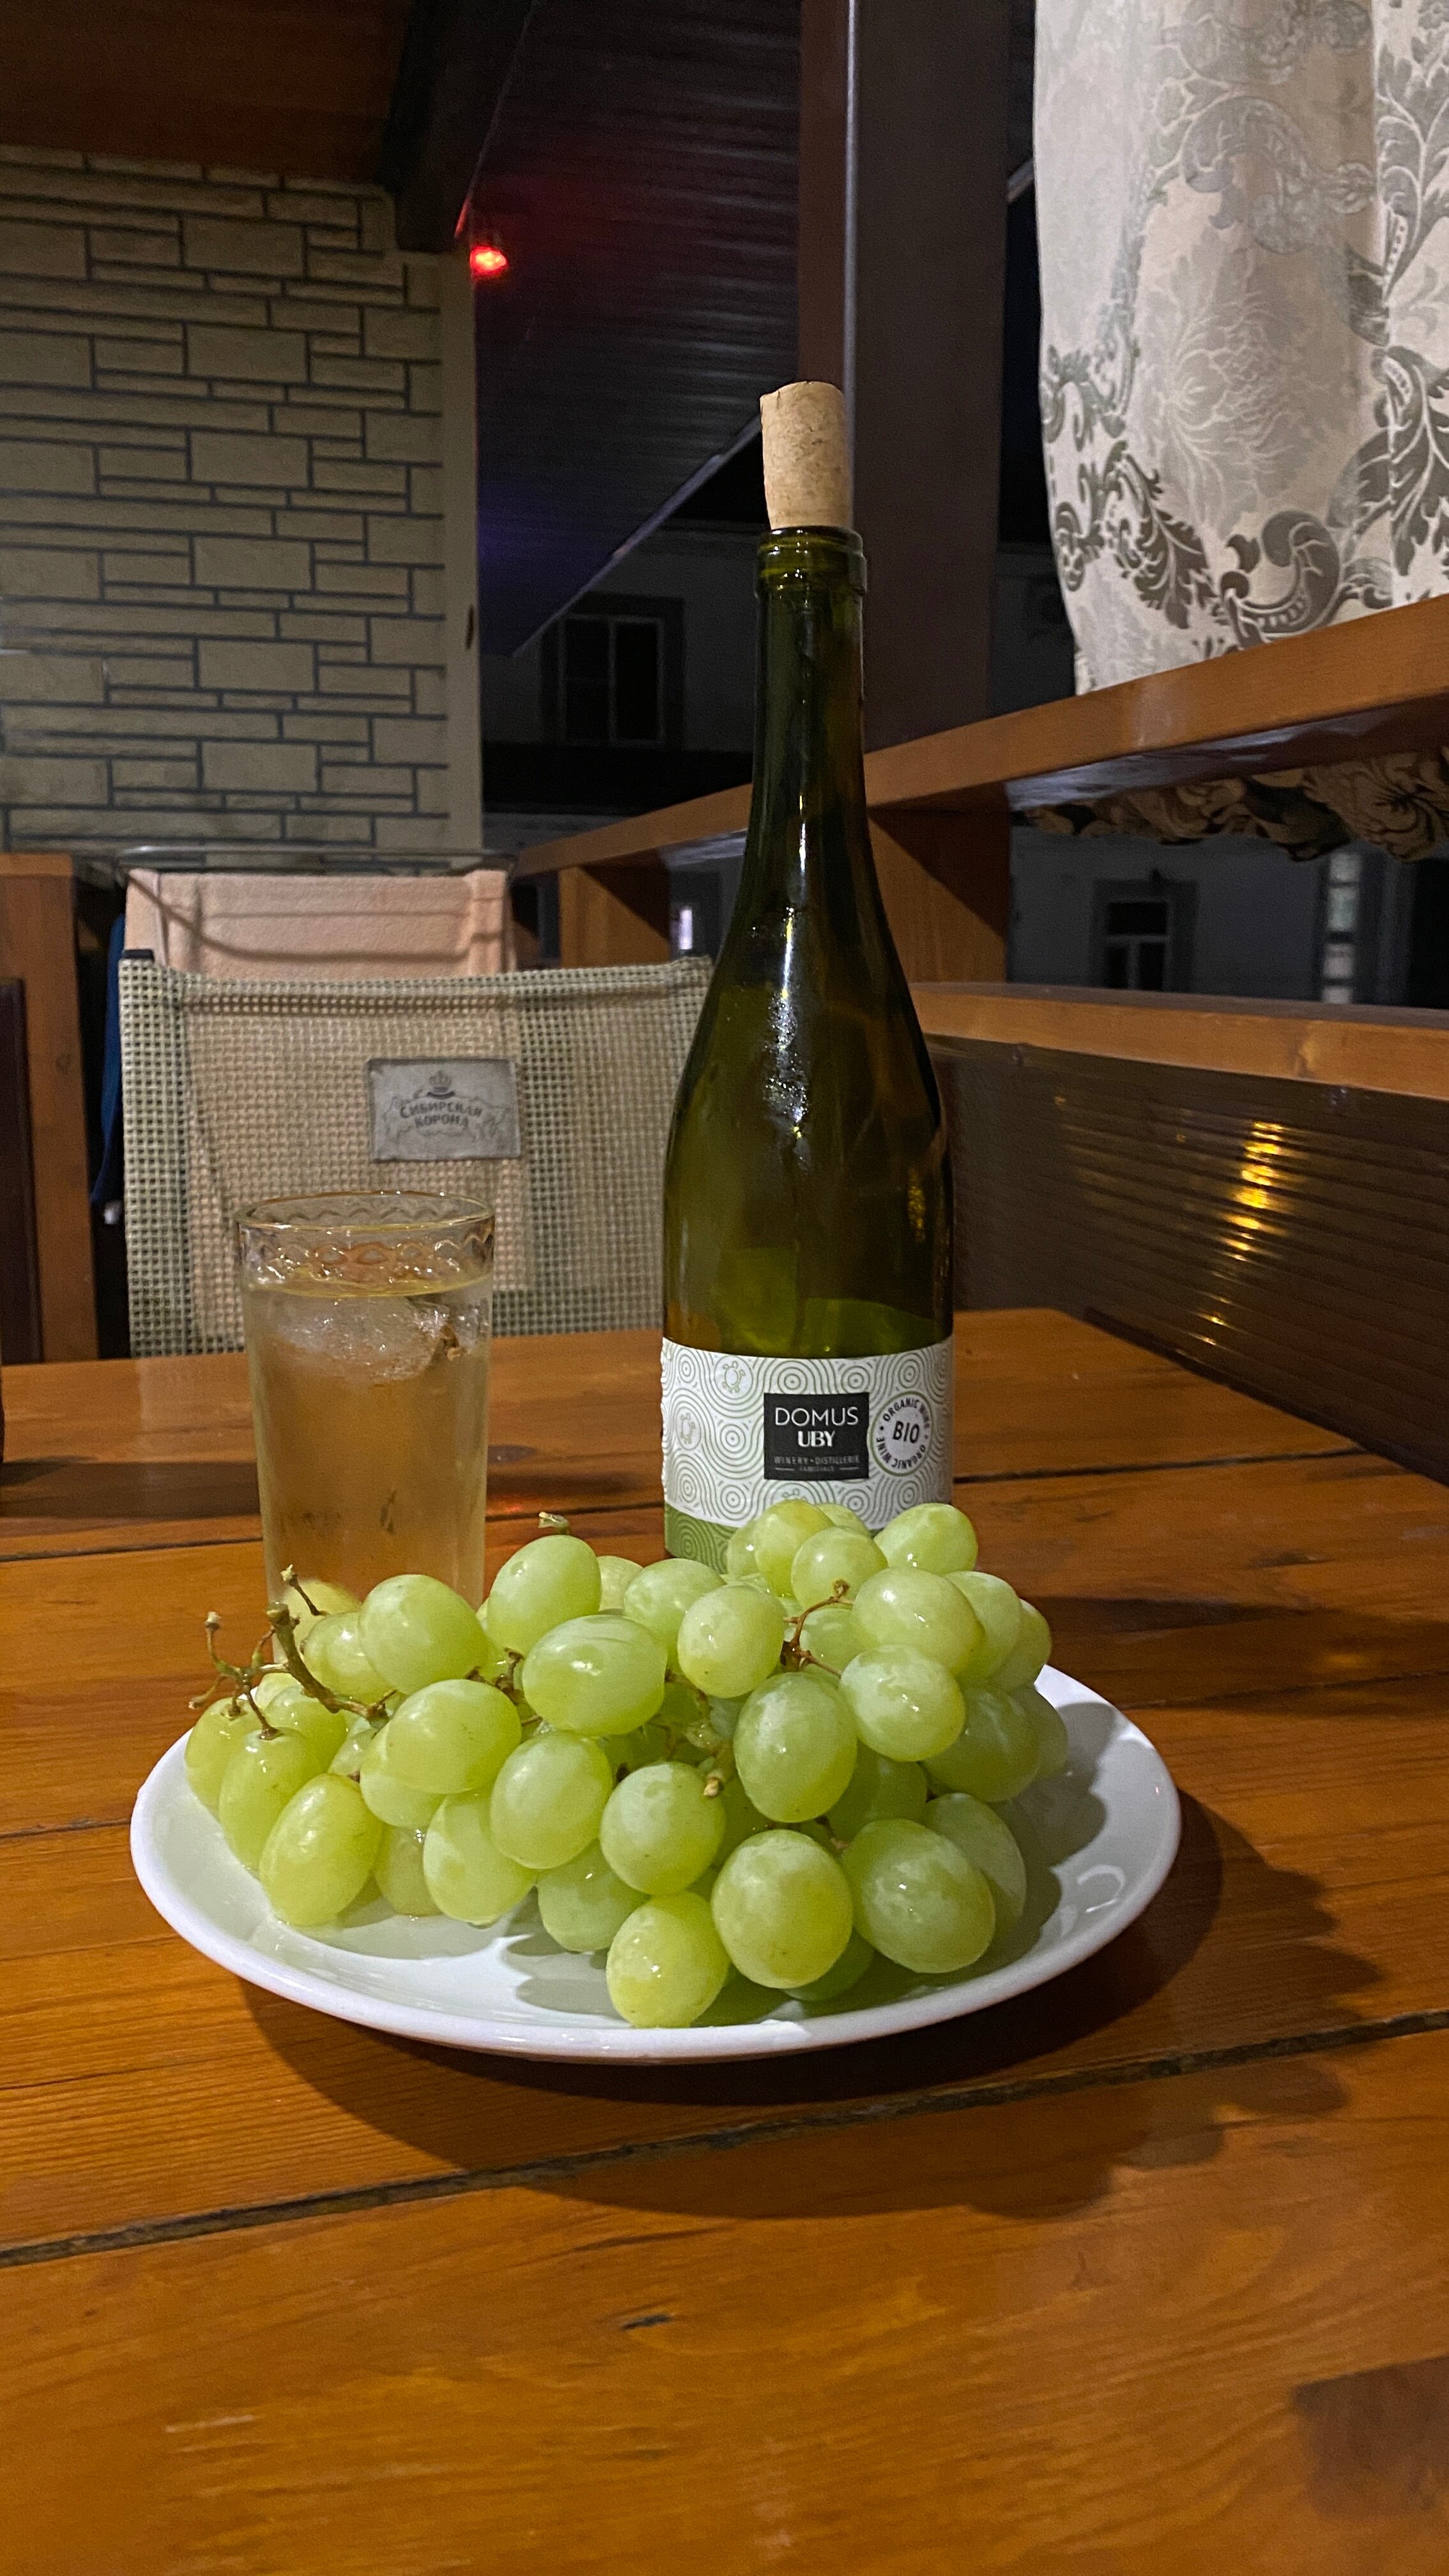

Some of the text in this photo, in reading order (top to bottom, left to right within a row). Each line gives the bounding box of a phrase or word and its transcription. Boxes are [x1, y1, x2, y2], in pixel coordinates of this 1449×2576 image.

[400, 1101, 482, 1118] СИБИРСКАЯ
[414, 1114, 468, 1130] КОРОНА
[775, 1407, 859, 1427] DOMUS
[883, 1397, 920, 1422] ORGANIC
[798, 1430, 836, 1448] UBY
[892, 1420, 920, 1444] BIO
[774, 1454, 859, 1465] WINERY DISTILLERIE
[876, 1436, 926, 1469] ORGANIC WINE
